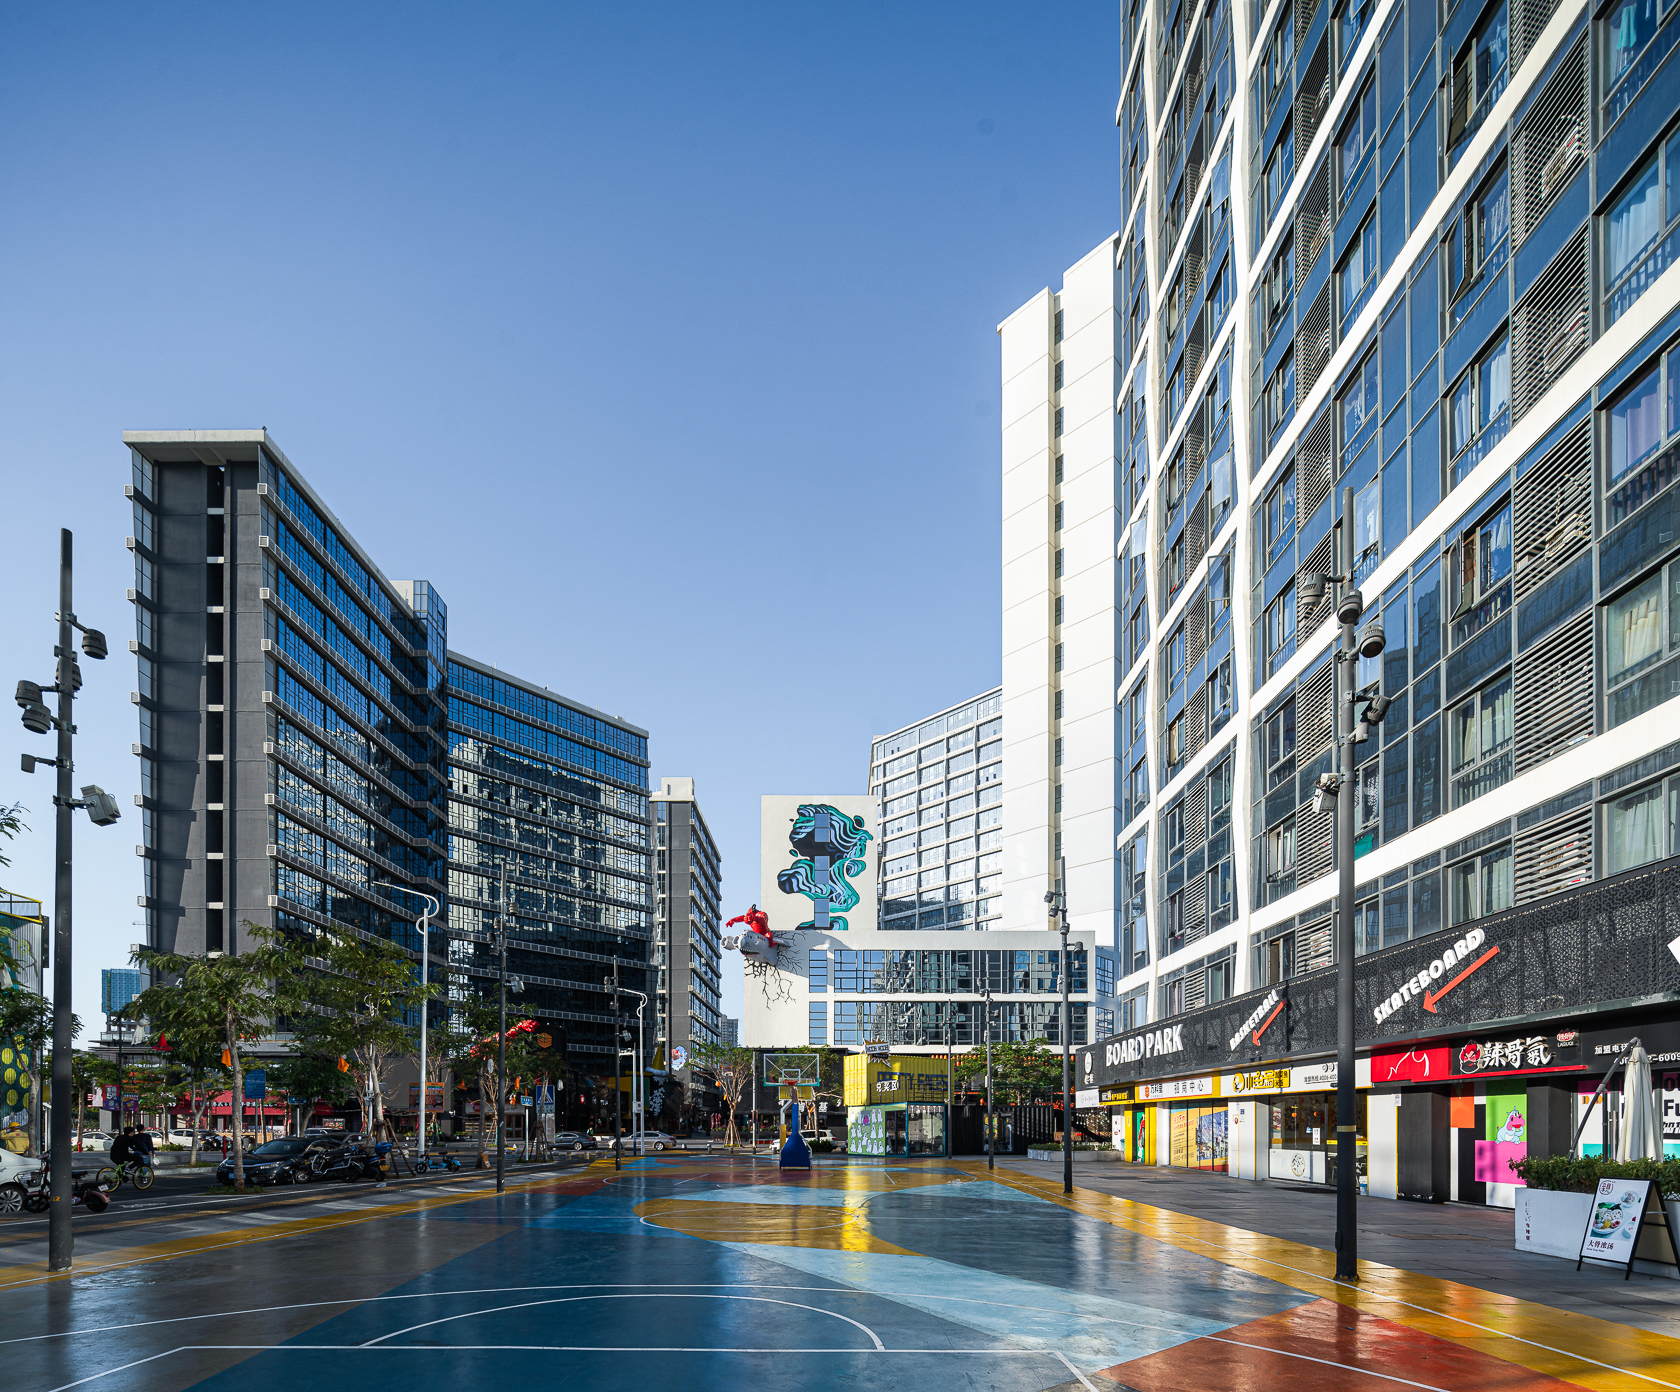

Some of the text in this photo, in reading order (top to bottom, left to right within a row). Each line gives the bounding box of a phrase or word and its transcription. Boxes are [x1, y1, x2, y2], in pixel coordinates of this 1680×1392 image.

[1373, 928, 1485, 1025] SKATEBOARD
[1105, 1023, 1184, 1067] BOARD PARK
[1229, 989, 1279, 1051] BASKETBALL
[1174, 1080, 1204, 1094] 招商中心
